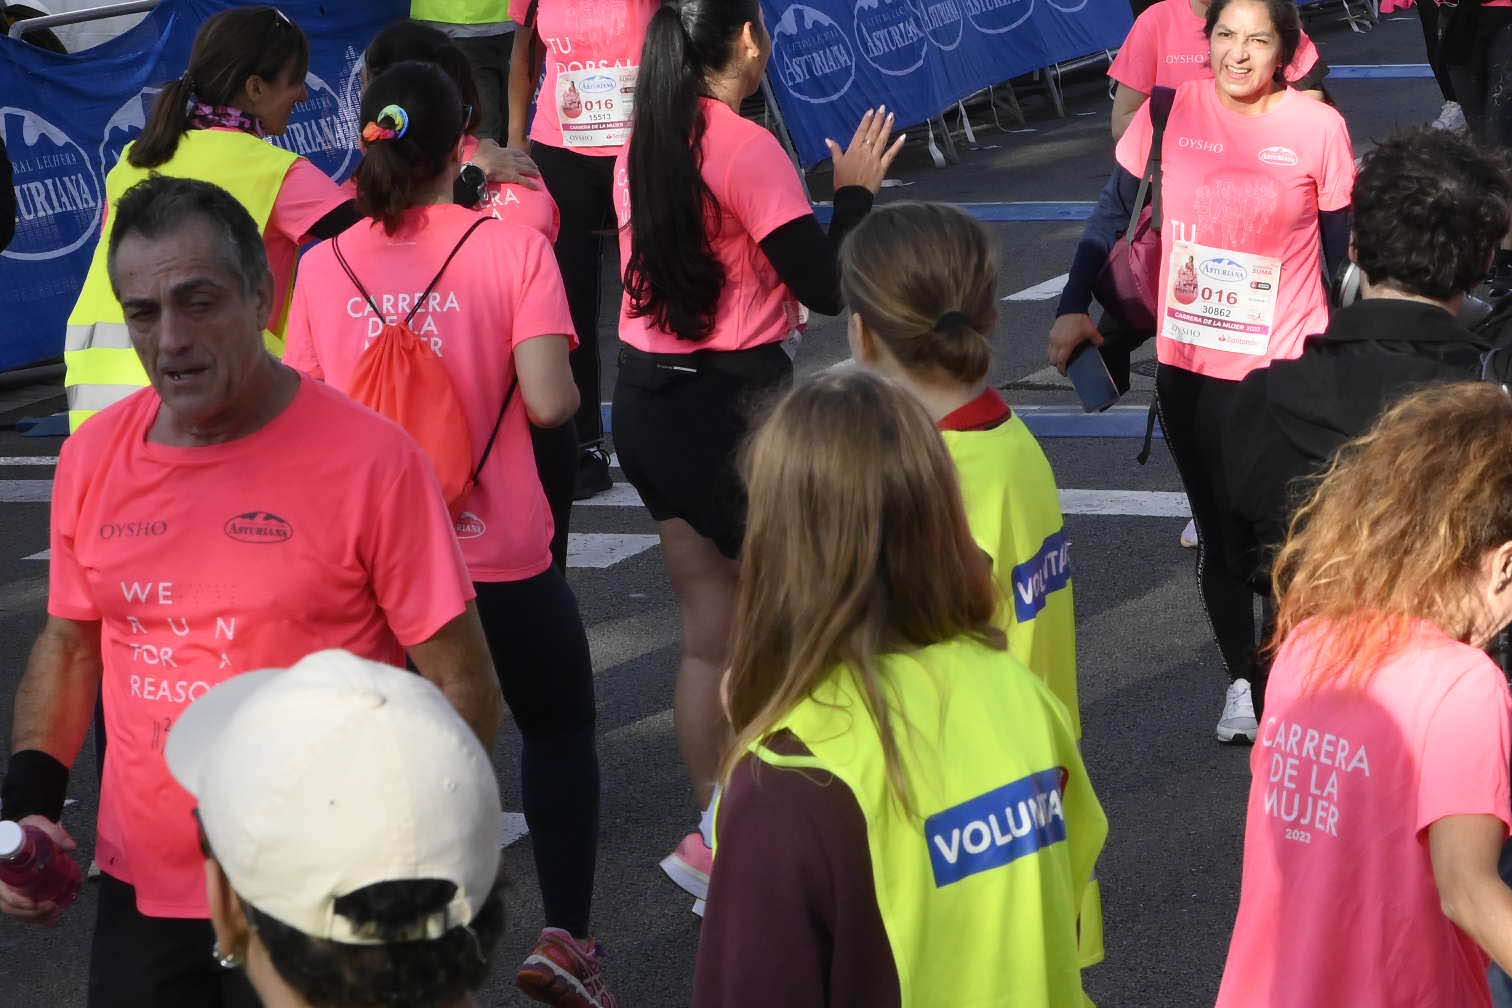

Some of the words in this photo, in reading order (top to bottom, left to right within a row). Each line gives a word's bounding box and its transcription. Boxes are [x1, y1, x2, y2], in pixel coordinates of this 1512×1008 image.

[550, 37, 573, 56] TU
[1166, 54, 1205, 65] OYSHO
[585, 99, 614, 112] 016
[1178, 136, 1224, 153] OYSHO
[1170, 219, 1197, 244] TU
[347, 291, 461, 319] CARRERA
[1201, 287, 1238, 305] 016
[1202, 305, 1232, 318] 30862
[100, 519, 168, 540] OYSHO
[120, 581, 174, 605] WE
[130, 675, 214, 703] REASO
[1262, 717, 1370, 777] CARRERA
[1269, 753, 1299, 789] DE
[1310, 764, 1339, 802] LA
